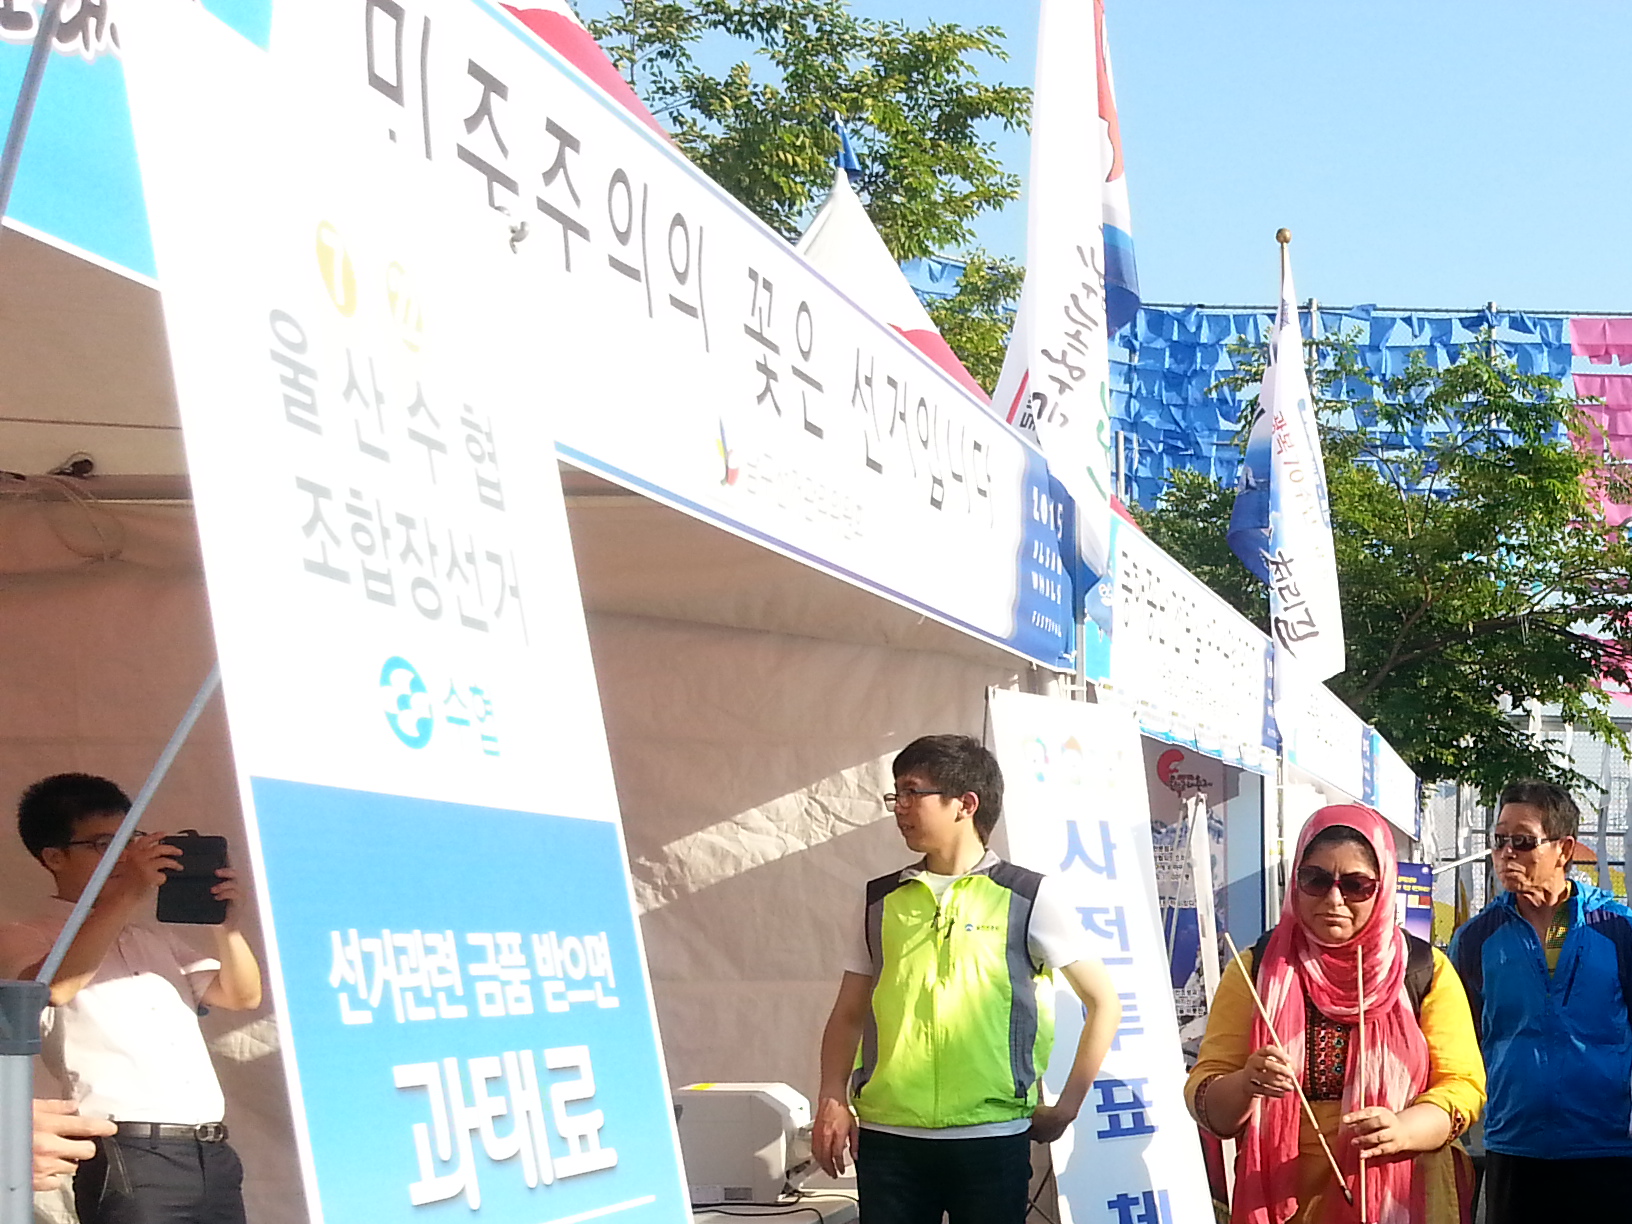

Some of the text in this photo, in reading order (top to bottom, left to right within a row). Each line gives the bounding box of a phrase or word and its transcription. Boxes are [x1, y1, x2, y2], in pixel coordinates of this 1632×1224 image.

[744, 266, 824, 440] 꽃은
[852, 347, 994, 529] 선거입니다
[295, 475, 529, 647] 조합장선거
[1032, 485, 1063, 539] 2015
[329, 927, 621, 1026] 선거관련 금품 받으면
[392, 1044, 619, 1211] 과태료
